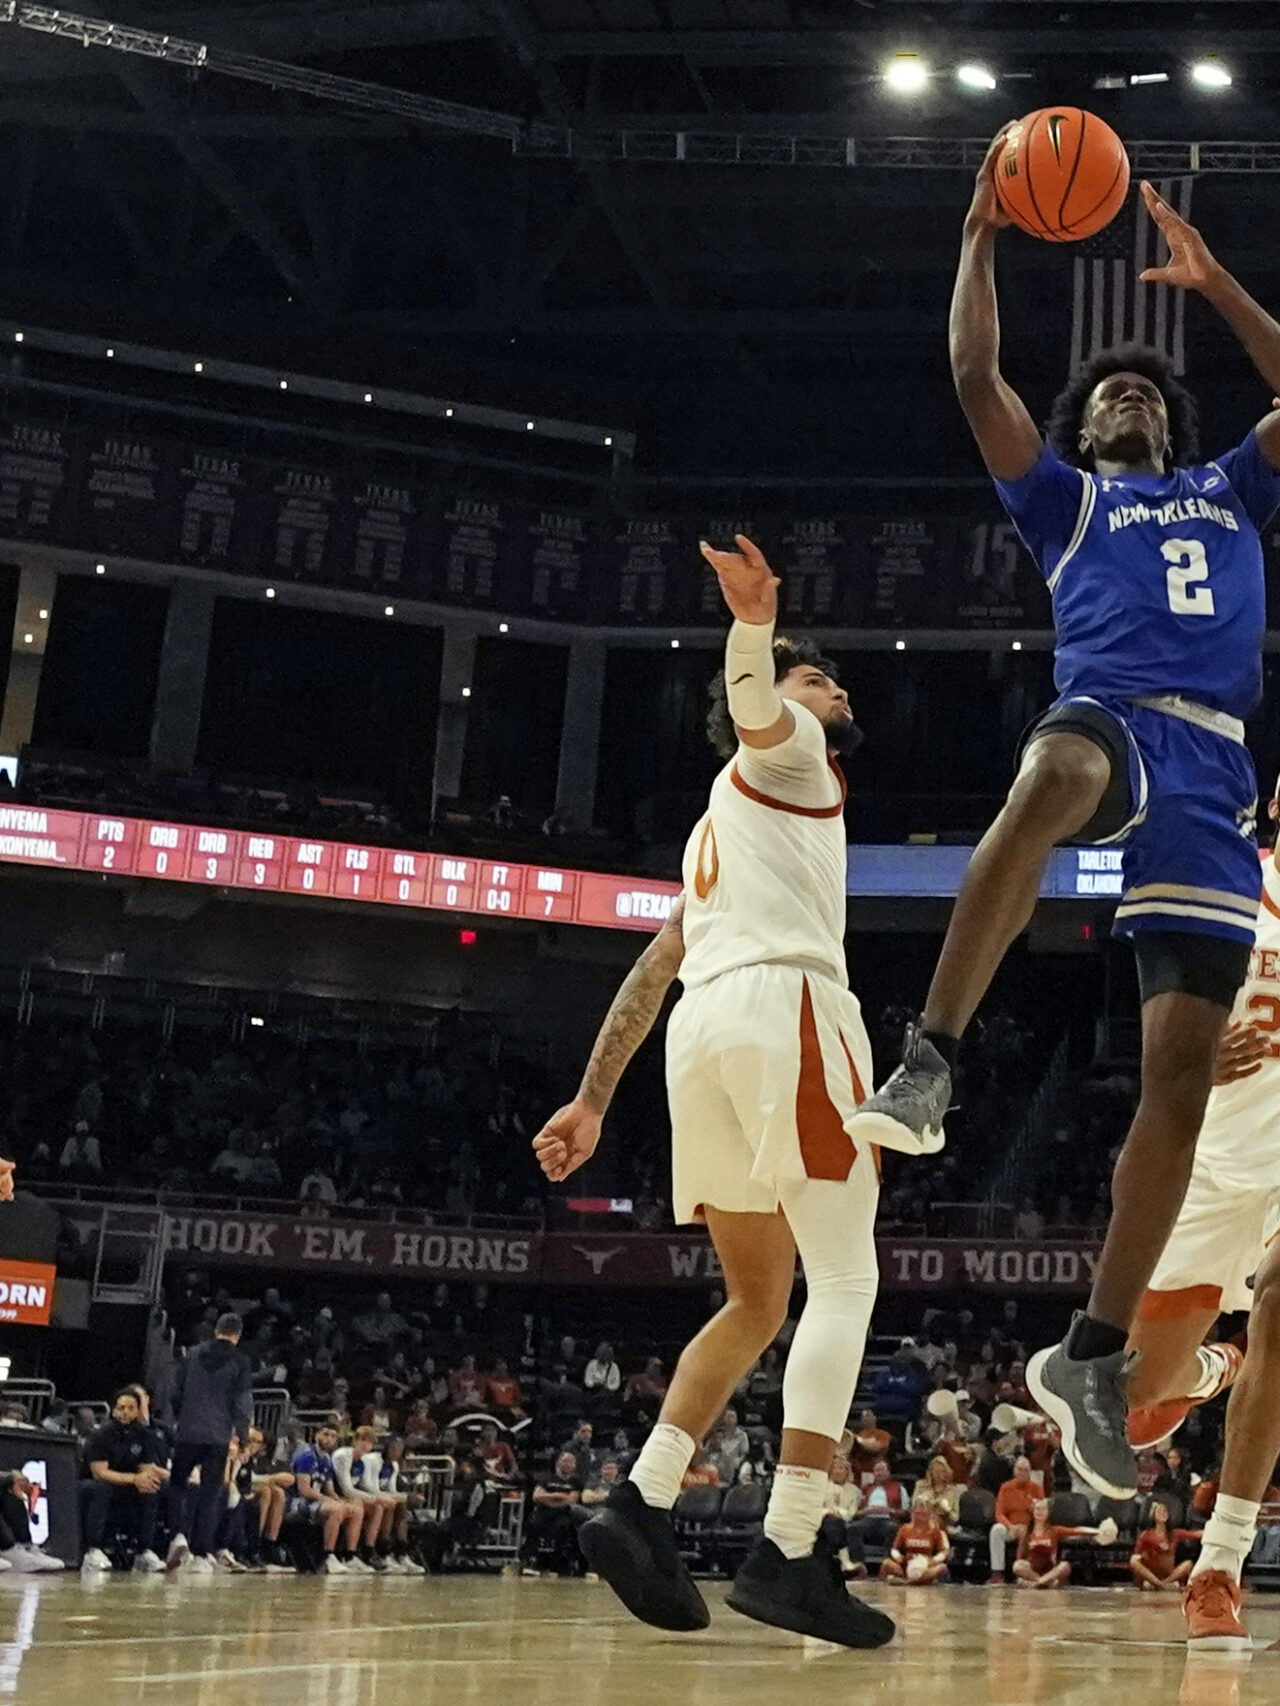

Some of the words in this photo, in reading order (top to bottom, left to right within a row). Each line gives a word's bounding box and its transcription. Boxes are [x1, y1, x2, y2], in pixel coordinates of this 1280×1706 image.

[1108, 502, 1150, 533] NEW
[1160, 538, 1215, 616] 2
[98, 819, 125, 843] PTS
[103, 846, 115, 869] 2
[248, 837, 275, 860] REB
[297, 843, 324, 865] AST
[345, 848, 369, 870] FLS
[156, 852, 168, 874] 0
[206, 858, 218, 880] 3
[254, 863, 266, 885] 3
[393, 854, 416, 876] STL
[441, 859, 467, 882] BLK
[303, 868, 314, 890] 0
[353, 874, 360, 895] 1
[492, 866, 508, 886] FT
[537, 871, 564, 892] MIN
[399, 879, 410, 901] 0
[446, 885, 457, 906] 0
[487, 889, 511, 912] 0-0
[543, 896, 554, 917] 7
[163, 1216, 278, 1257] HOOK
[392, 1232, 530, 1273] HORNS
[892, 1248, 943, 1282] TO
